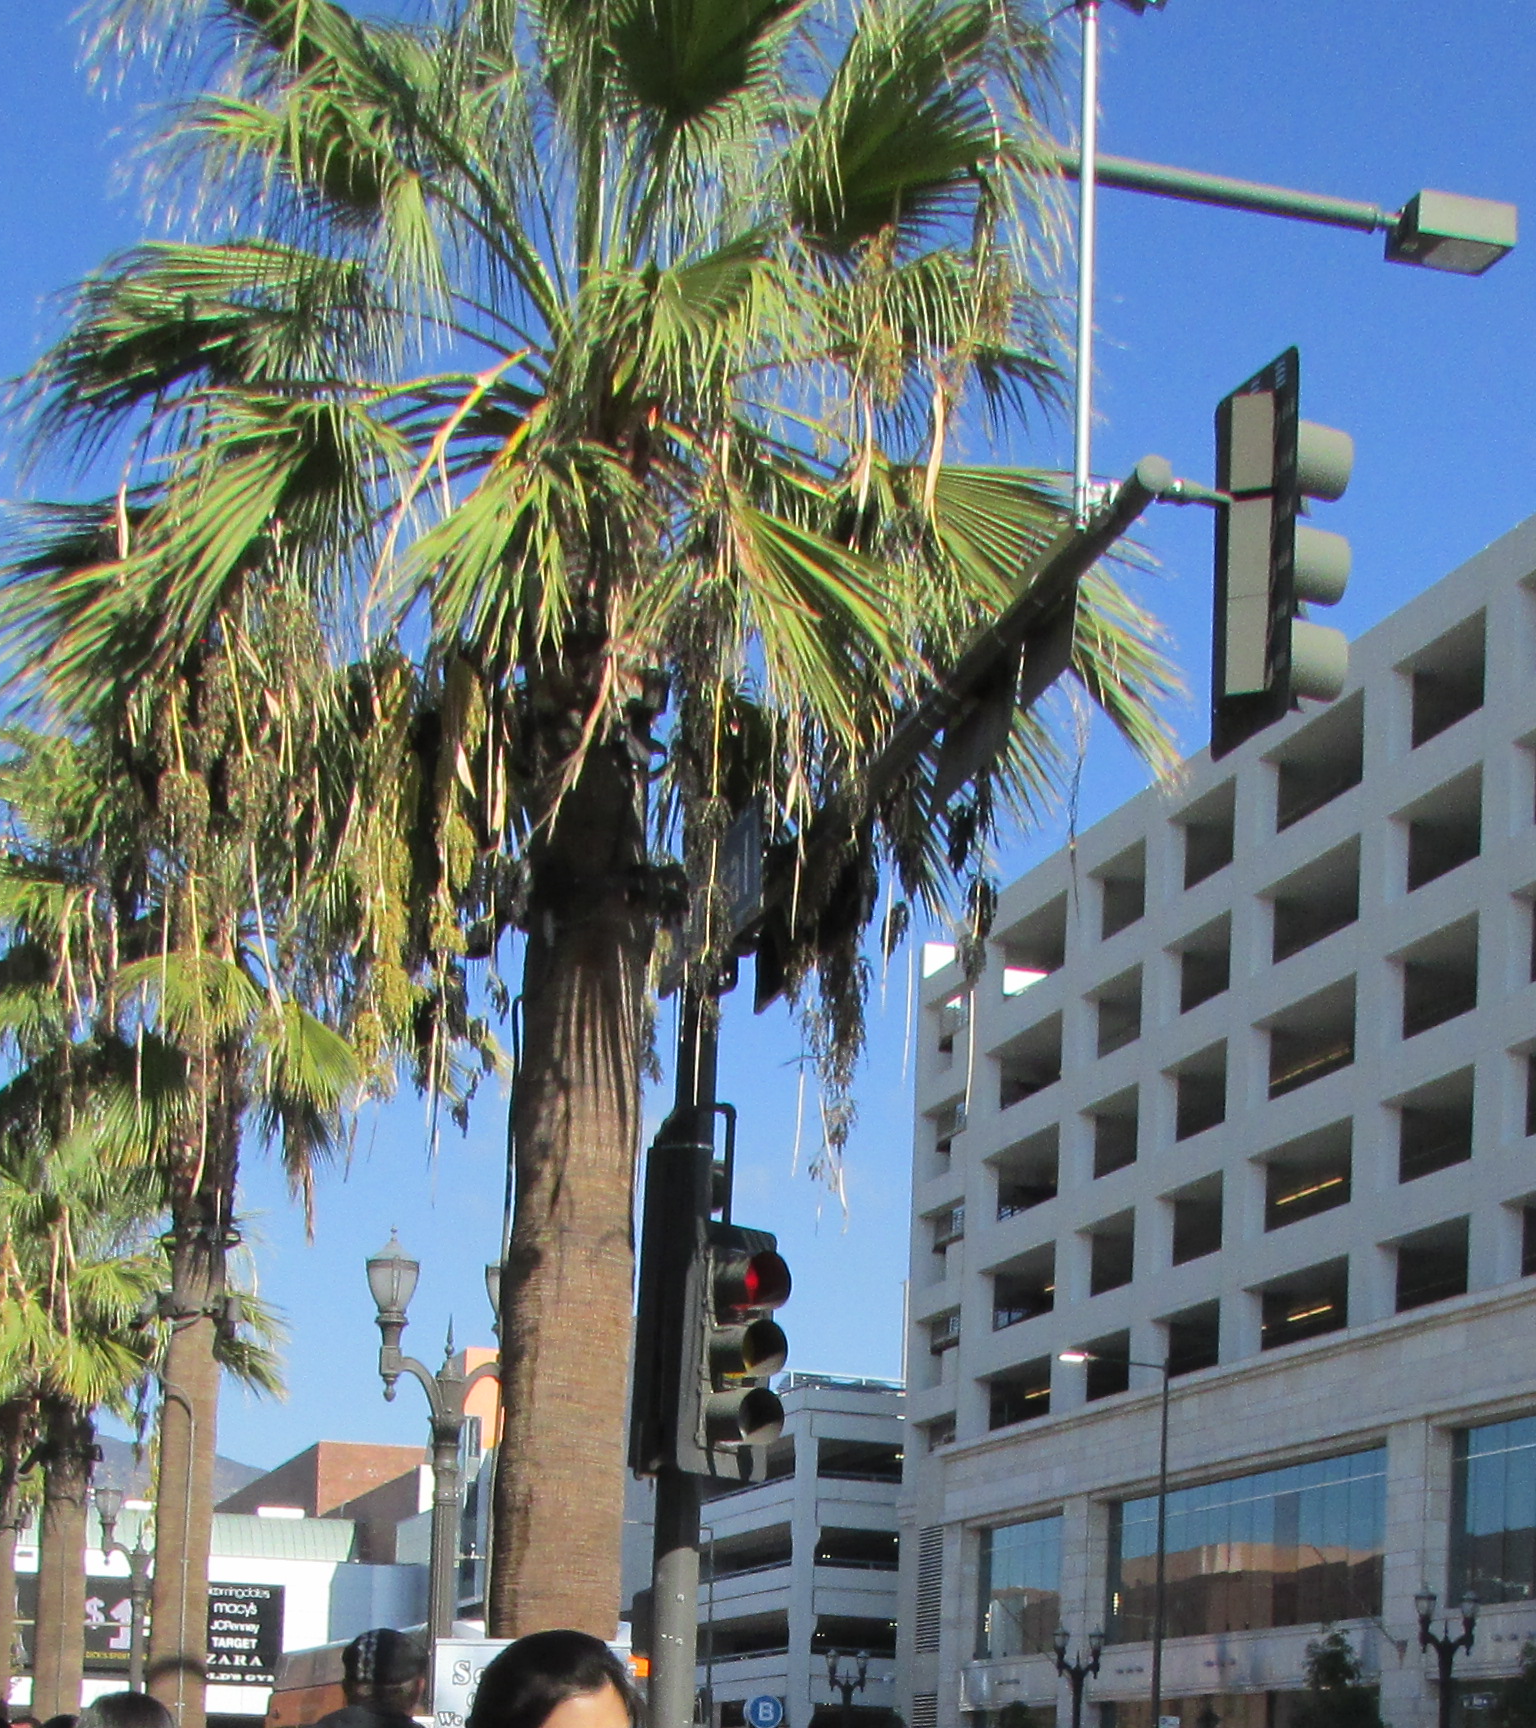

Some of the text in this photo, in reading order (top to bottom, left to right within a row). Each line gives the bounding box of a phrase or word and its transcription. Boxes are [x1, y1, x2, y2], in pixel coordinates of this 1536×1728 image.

[213, 1601, 259, 1618] macy's
[210, 1618, 261, 1635] JCPenney
[210, 1636, 259, 1650] TARGET
[206, 1652, 264, 1668] ZARA
[758, 1701, 775, 1722] B
